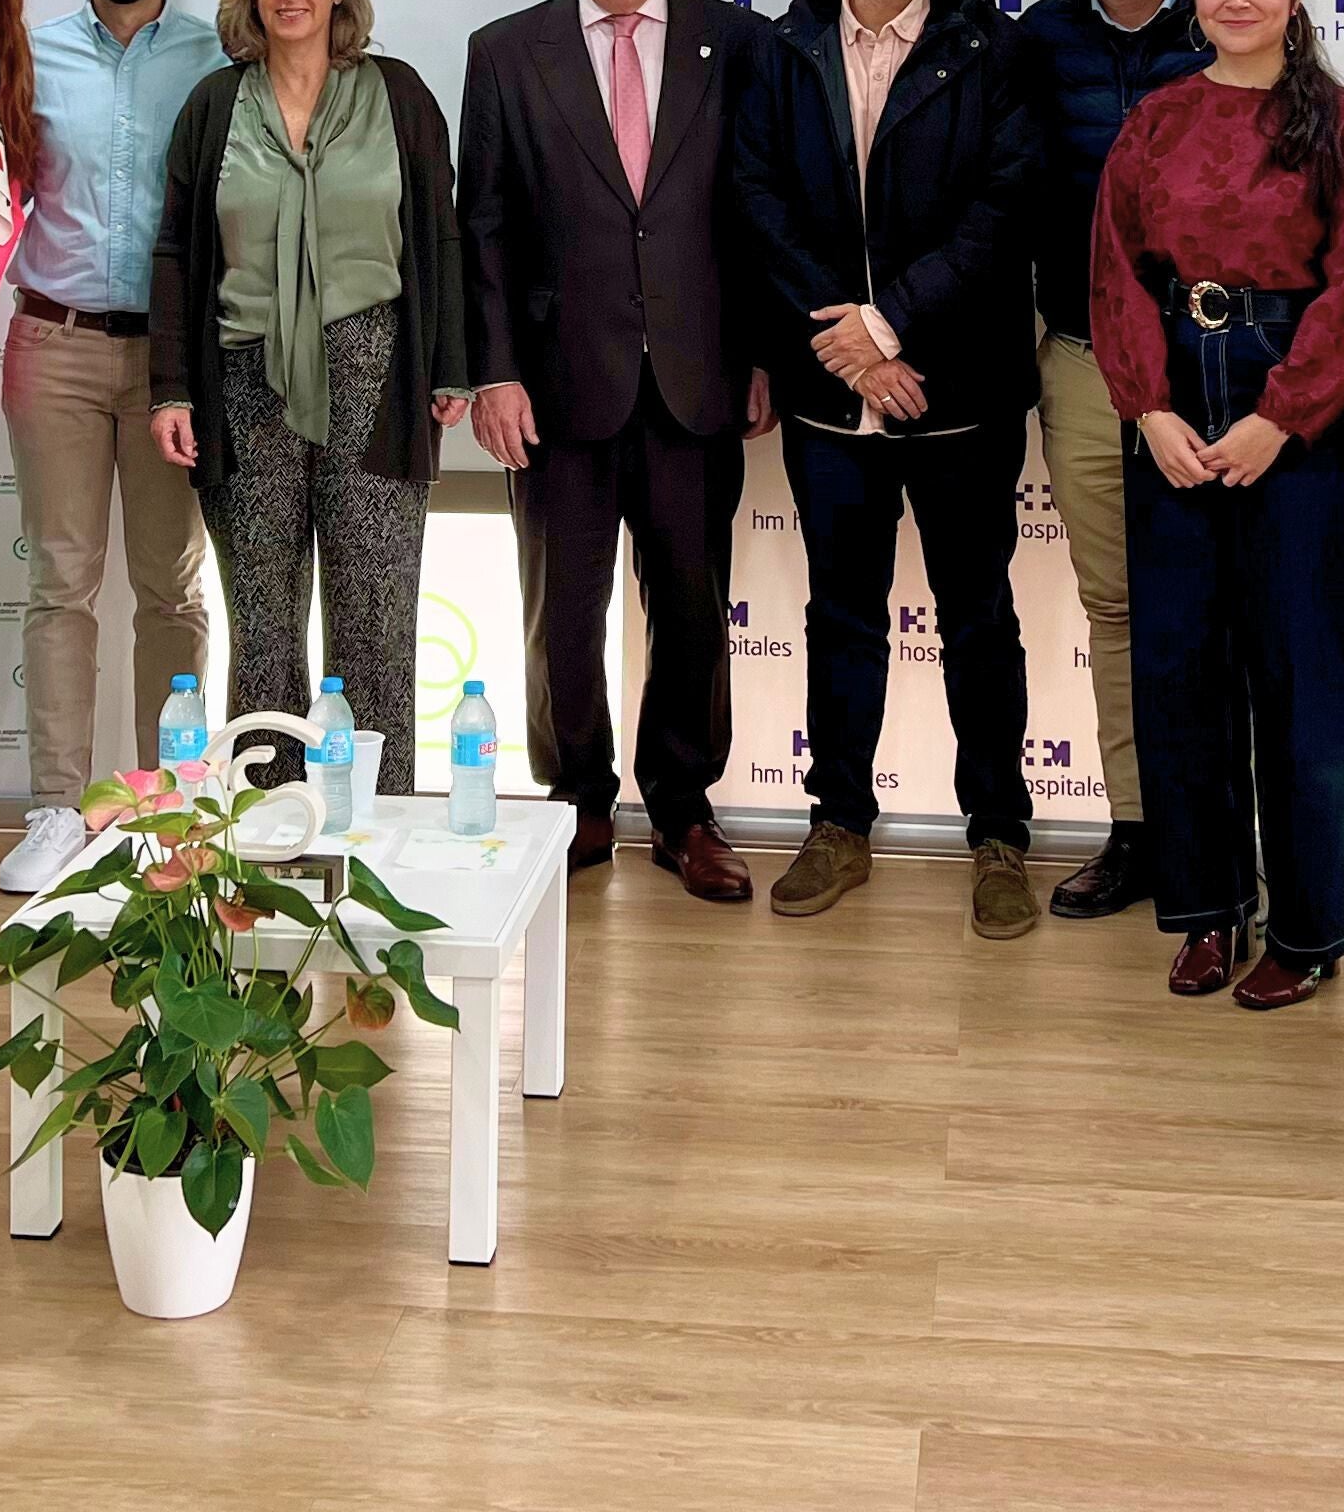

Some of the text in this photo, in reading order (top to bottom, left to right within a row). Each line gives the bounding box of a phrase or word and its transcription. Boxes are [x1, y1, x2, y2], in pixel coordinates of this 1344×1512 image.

[752, 509, 784, 531] hm
[751, 762, 783, 784] hm
[1024, 774, 1105, 800] ospitale
